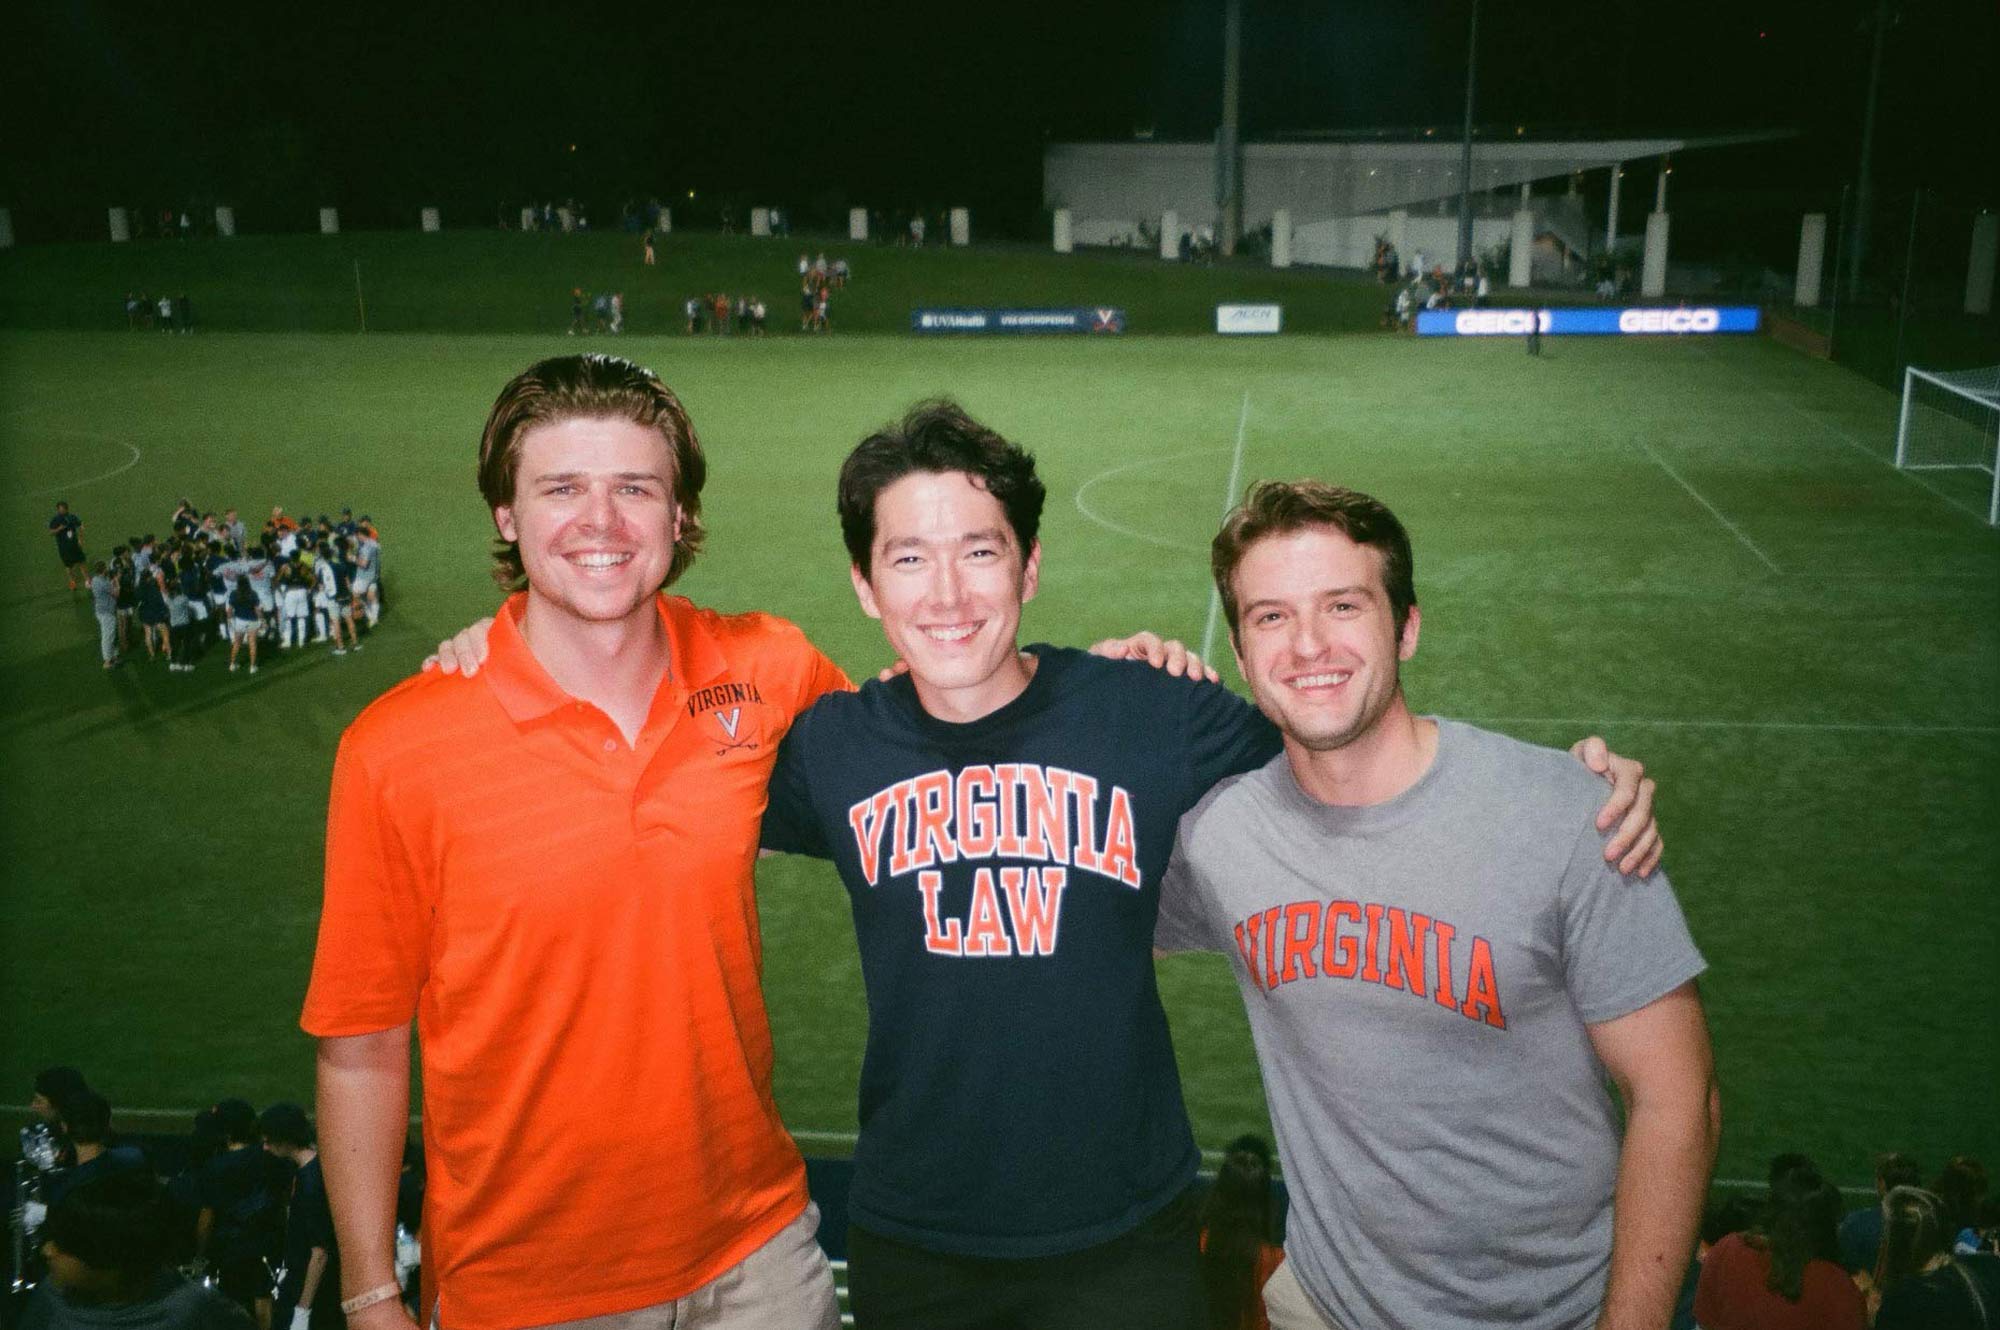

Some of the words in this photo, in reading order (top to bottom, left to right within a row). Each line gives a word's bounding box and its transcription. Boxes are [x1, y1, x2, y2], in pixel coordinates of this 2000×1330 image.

[1619, 308, 1719, 332] GEICO
[687, 683, 764, 718] VIRGINIA
[849, 763, 1141, 890] VIRGINIA
[918, 866, 1067, 957] LAW
[1234, 900, 1507, 1030] VIRGINIA
